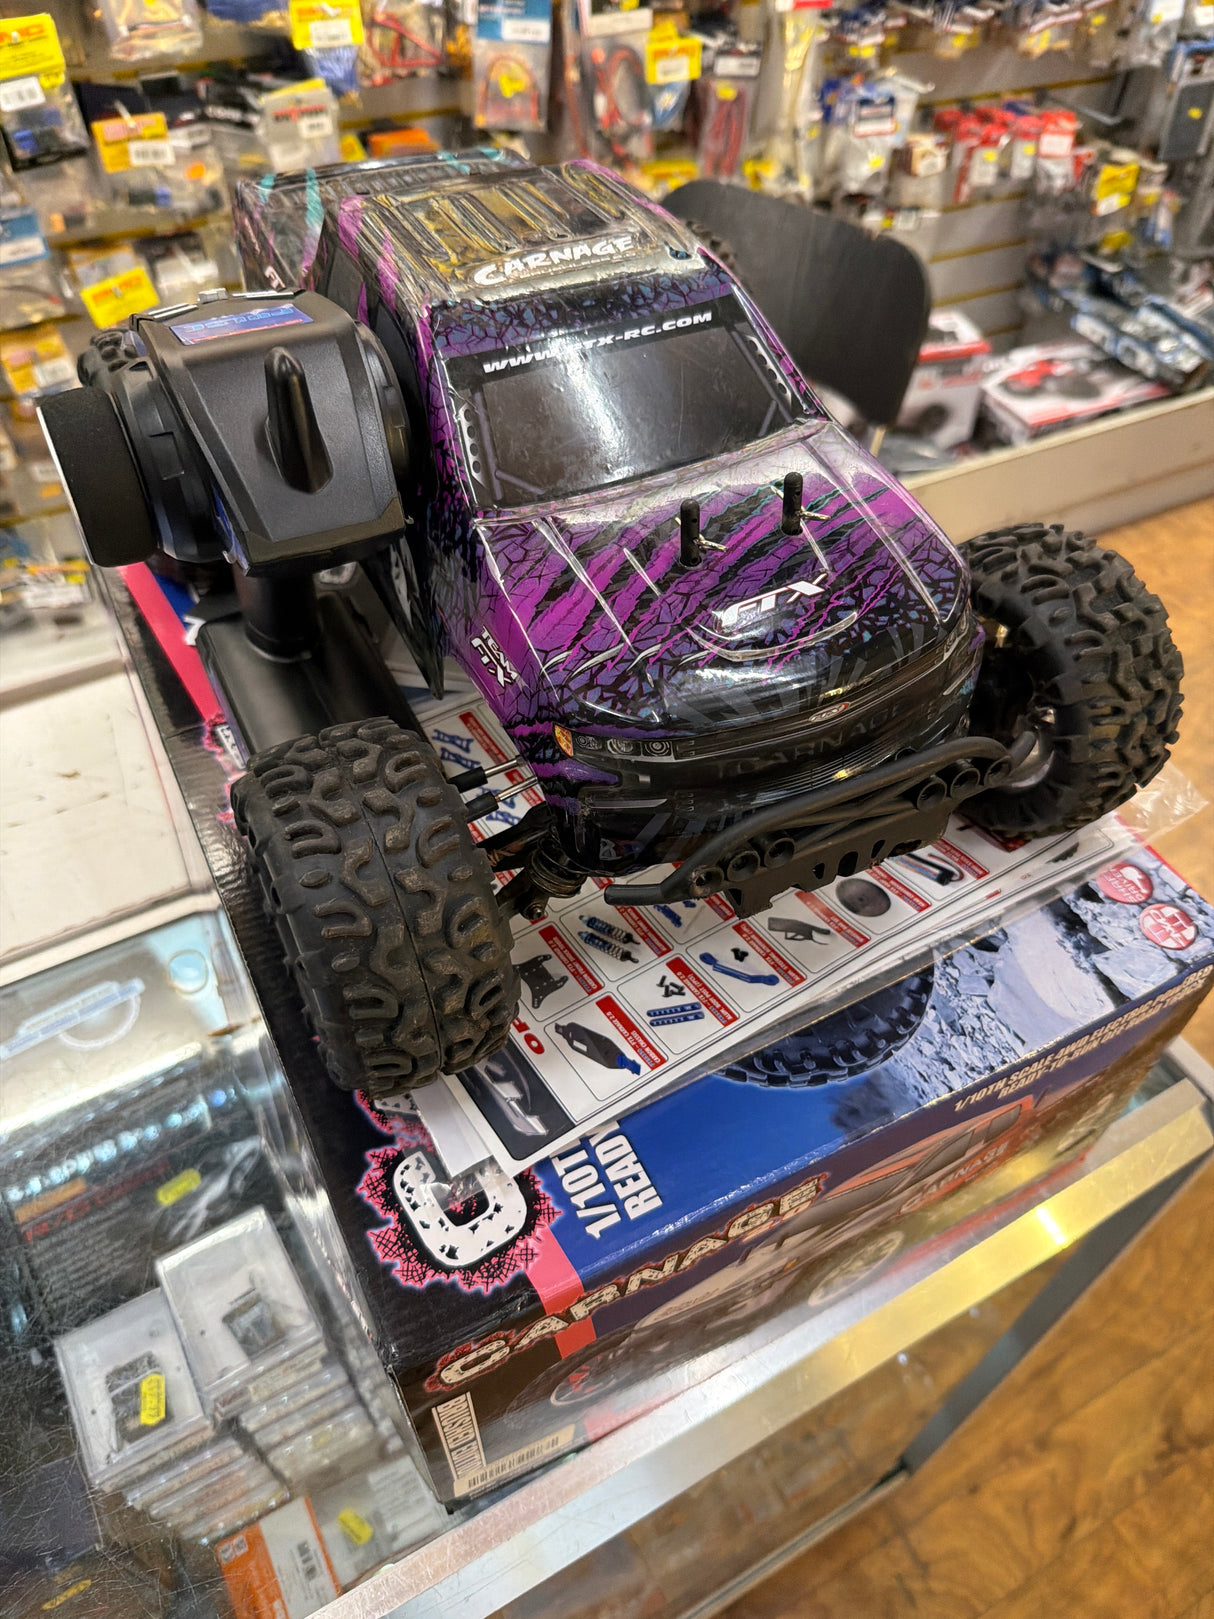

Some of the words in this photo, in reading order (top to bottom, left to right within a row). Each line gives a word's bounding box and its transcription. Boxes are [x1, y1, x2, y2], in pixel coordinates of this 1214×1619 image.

[472, 235, 635, 286] CARNAGE
[482, 311, 714, 374] WWWTX-RC.COM
[720, 572, 828, 628] FTX
[470, 636, 513, 687] FTX
[480, 625, 520, 680] TEAM
[1103, 871, 1137, 904] SHAF
[612, 1018, 630, 1037] CARNAGE
[630, 1029, 647, 1048] CHASSIS
[643, 1046, 661, 1064] CARBON
[954, 1076, 1009, 1113] 1/10TH
[1010, 1053, 1053, 1084] SCALE
[547, 1138, 622, 1242] 1/10T
[439, 1180, 822, 1385] CARNAGE
[436, 1394, 476, 1449] BRUSHED
[450, 1441, 484, 1479] EDITIO
